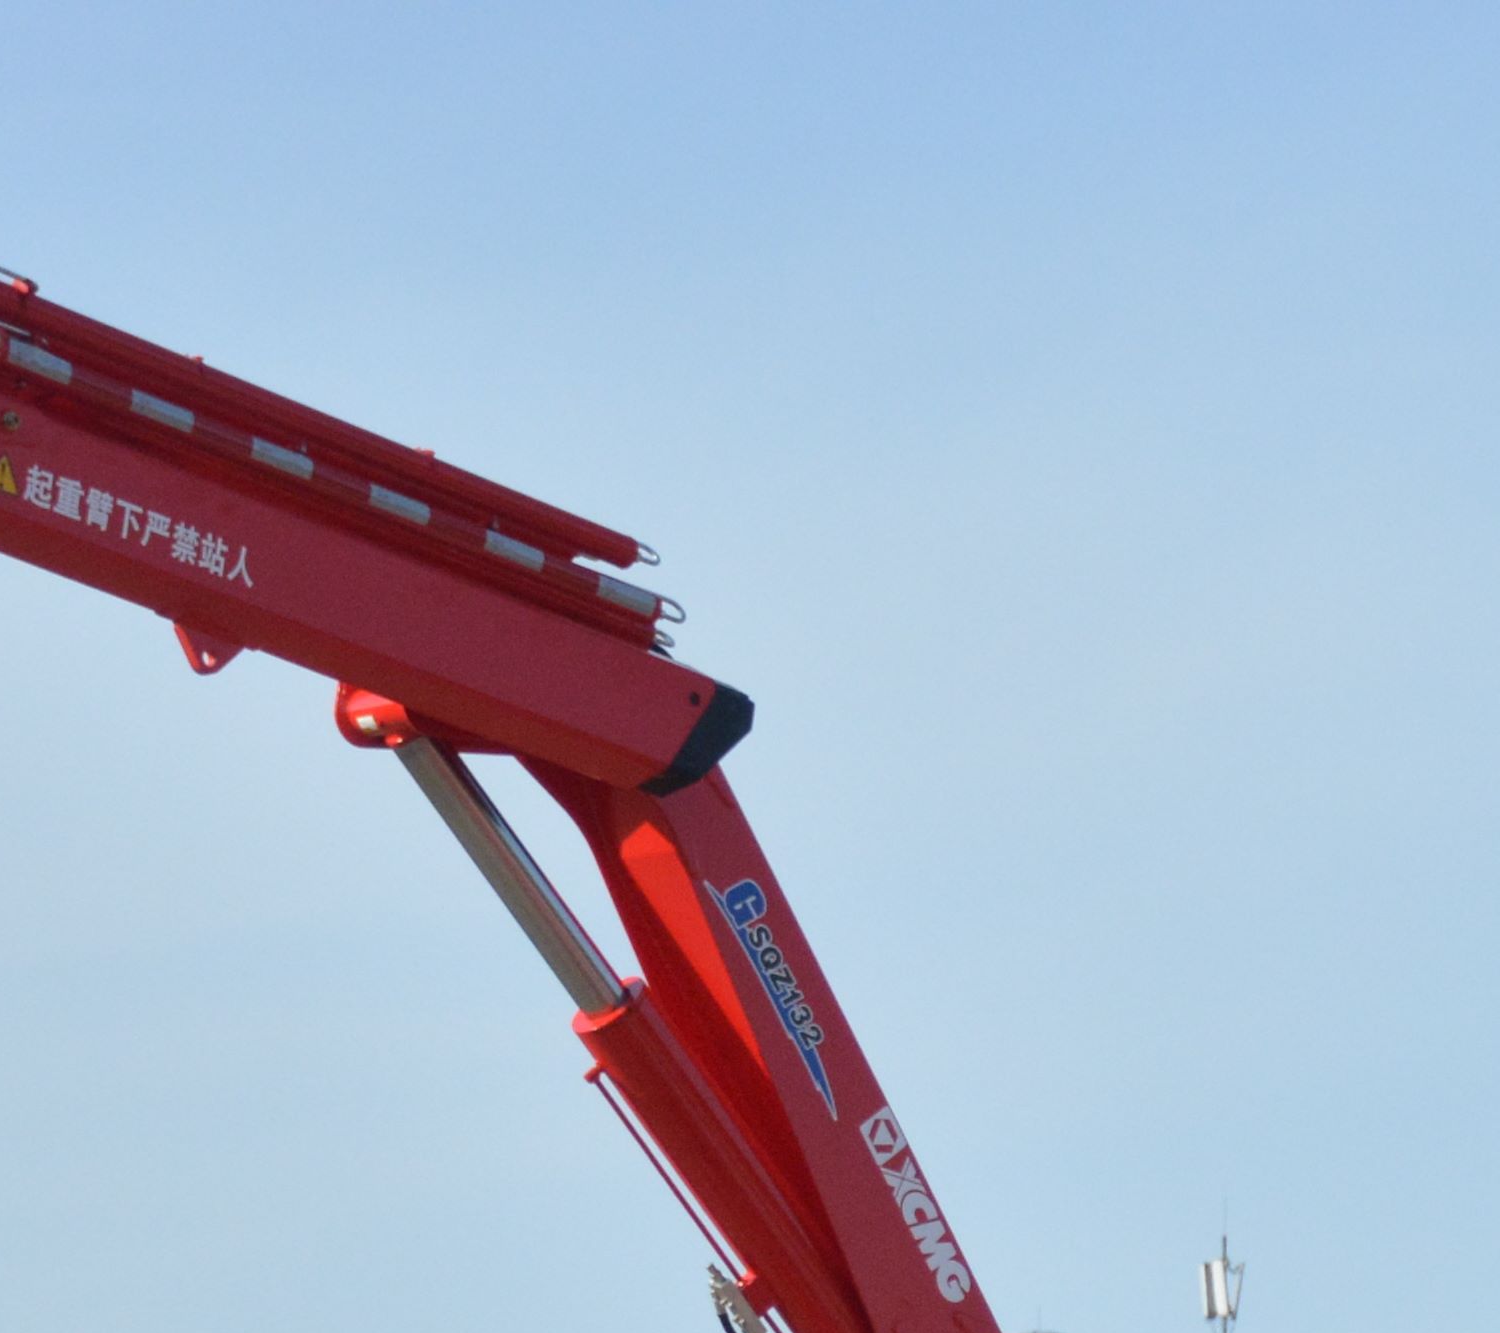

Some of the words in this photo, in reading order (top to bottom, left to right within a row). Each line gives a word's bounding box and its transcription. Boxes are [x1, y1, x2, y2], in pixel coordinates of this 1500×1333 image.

[23, 464, 254, 588] 起重臂下严禁站人
[880, 1156, 972, 1304] XCMG
